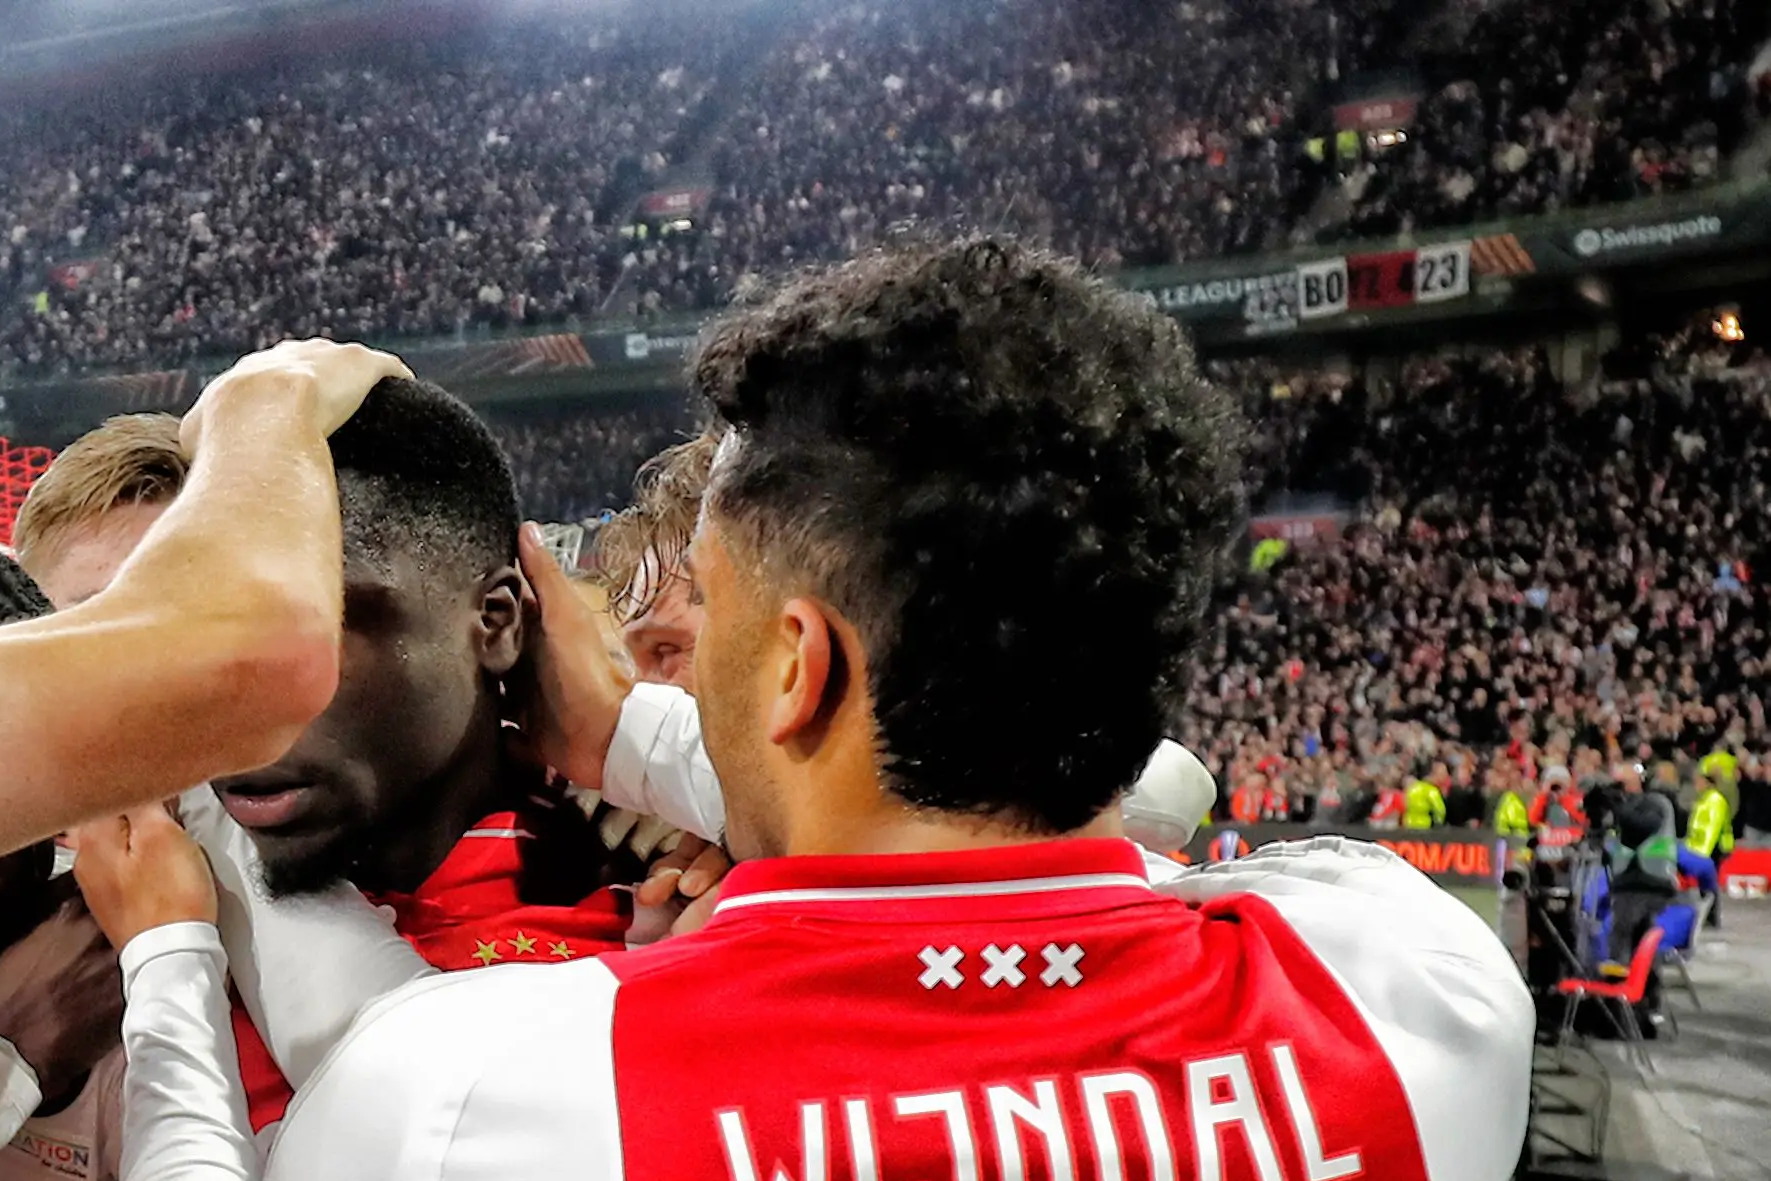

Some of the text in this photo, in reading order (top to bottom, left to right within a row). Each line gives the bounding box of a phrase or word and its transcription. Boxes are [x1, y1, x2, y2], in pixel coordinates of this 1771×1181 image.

[1601, 215, 1722, 250] Swissquote
[1163, 279, 1244, 308] LEAGU
[22, 1136, 89, 1168] ATION
